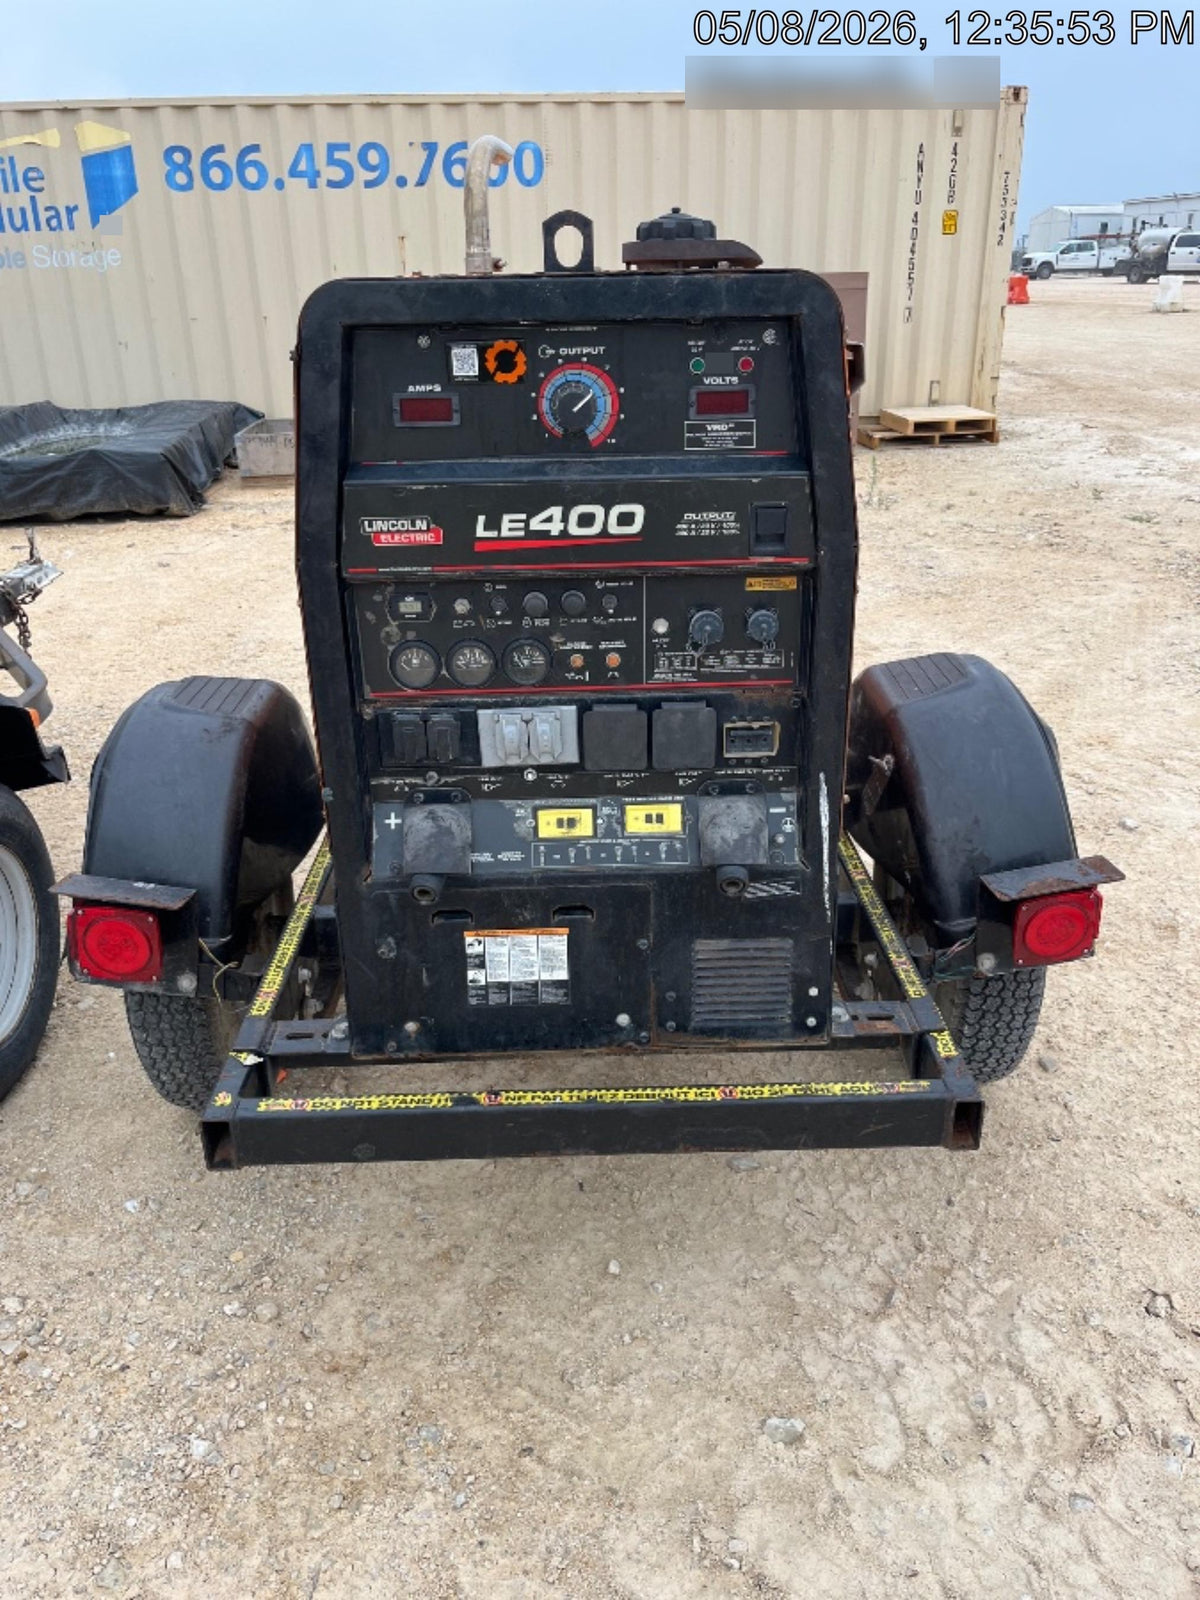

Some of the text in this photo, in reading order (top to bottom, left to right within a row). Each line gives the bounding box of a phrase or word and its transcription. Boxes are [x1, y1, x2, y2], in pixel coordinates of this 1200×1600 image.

[0, 195, 79, 233] ular
[32, 245, 122, 272] Storage
[559, 345, 606, 355] OUTPUT
[703, 375, 739, 385] VOLTS
[408, 384, 442, 392] AMPS
[363, 519, 428, 532] LINCOLN
[475, 503, 645, 538] LE400
[380, 532, 436, 543] ELECTRIC
[312, 1100, 337, 1109] DO
[341, 1098, 376, 1108] NOT
[378, 1096, 433, 1107] STAND
